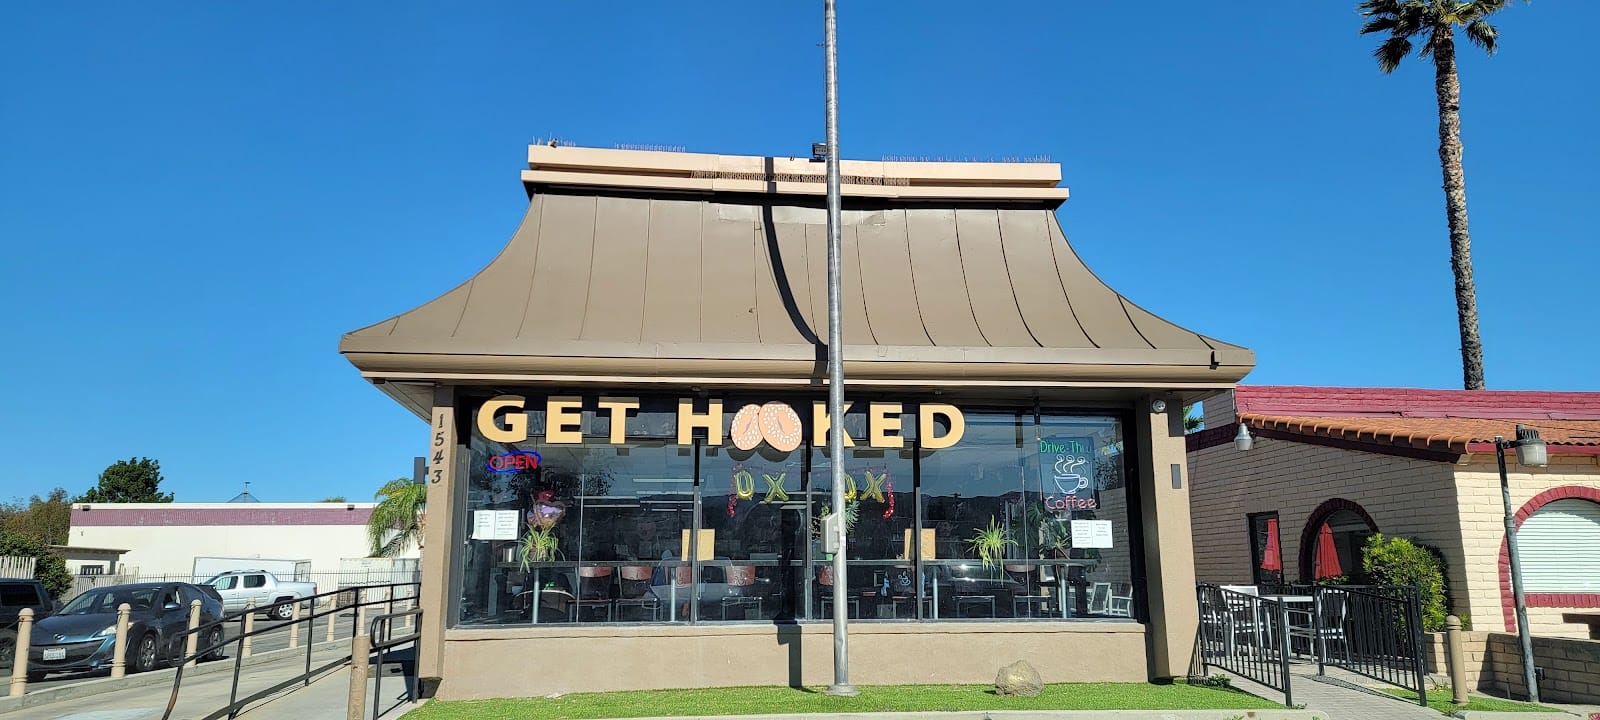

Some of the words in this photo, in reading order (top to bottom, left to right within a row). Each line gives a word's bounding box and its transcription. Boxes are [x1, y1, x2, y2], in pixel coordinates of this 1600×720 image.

[477, 395, 640, 444] GET
[431, 413, 445, 484] 1543
[489, 454, 539, 471] OPEN
[1045, 495, 1098, 510] Coffee
